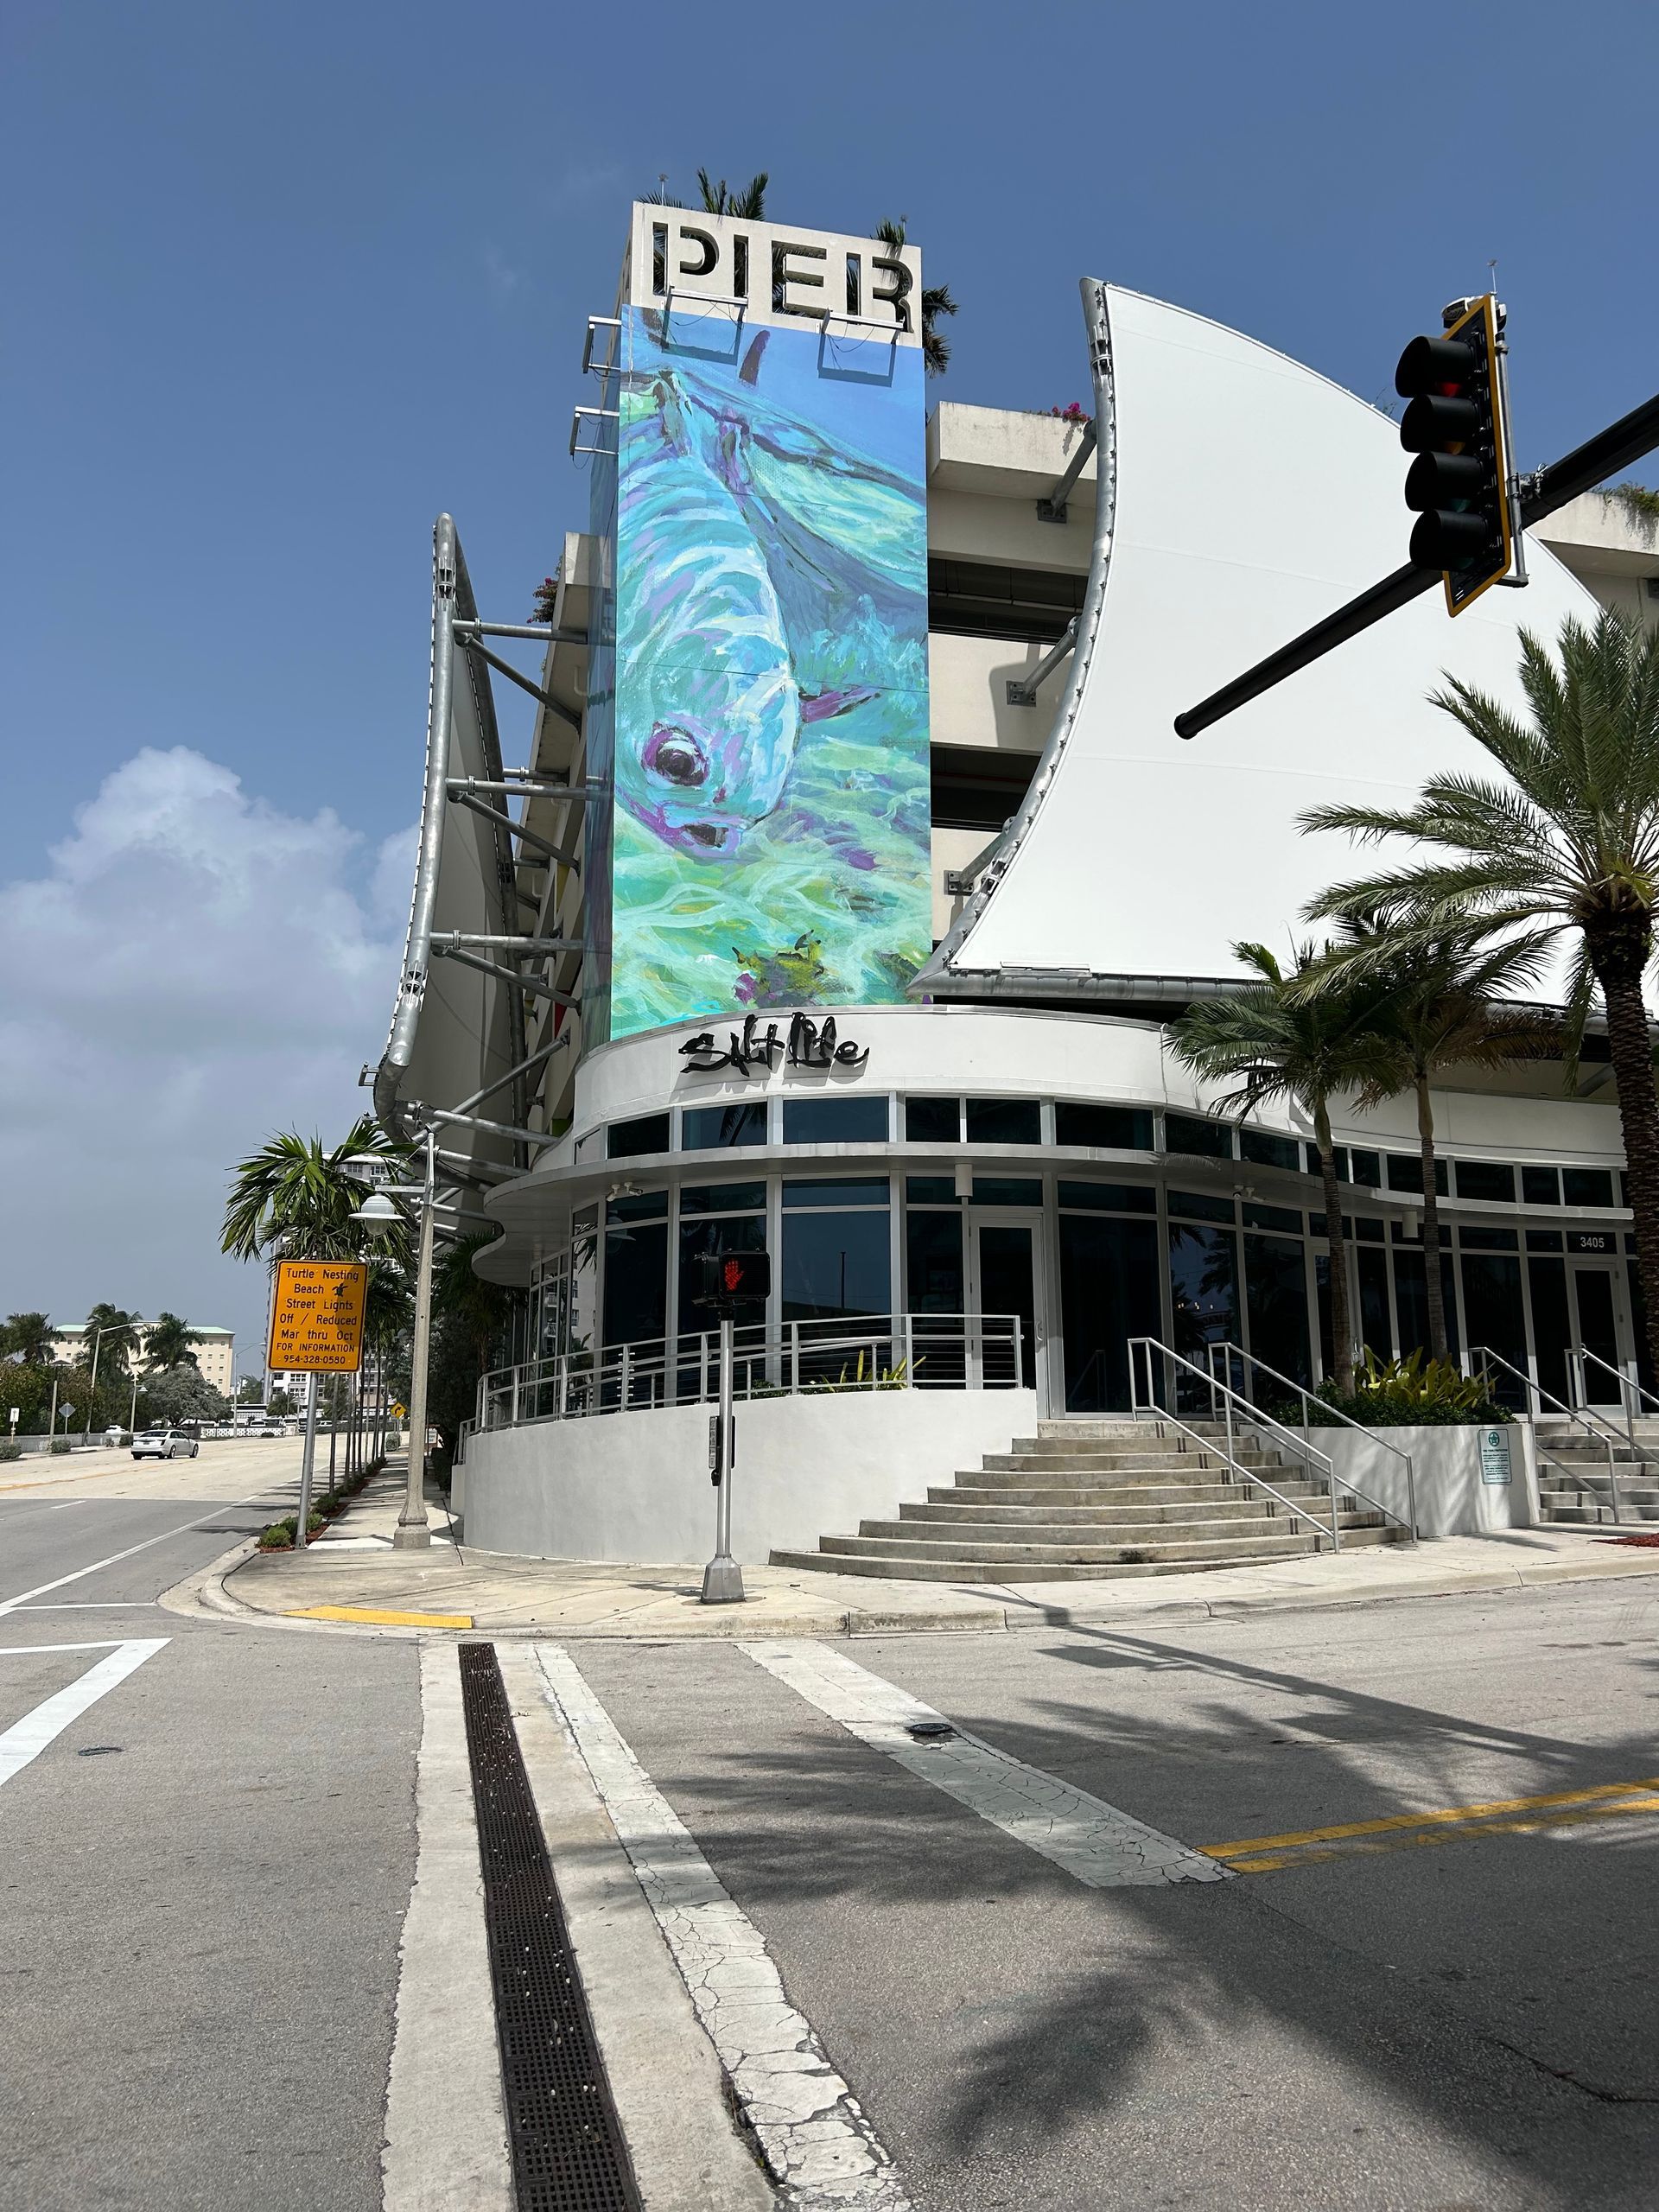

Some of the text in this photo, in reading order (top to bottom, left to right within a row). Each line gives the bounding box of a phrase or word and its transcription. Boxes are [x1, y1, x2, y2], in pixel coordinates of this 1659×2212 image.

[652, 221, 914, 334] PIER
[1580, 1236, 1605, 1249] 3405
[286, 1268, 359, 1283] Turtle Nesting
[294, 1283, 324, 1294] Beach
[286, 1298, 353, 1313] Street Lights
[279, 1313, 357, 1325] Off / Reduced
[281, 1329, 353, 1341] Mar thru Oct
[299, 1344, 355, 1352] INFORMATION
[283, 1354, 346, 1364] 954-328-0580
